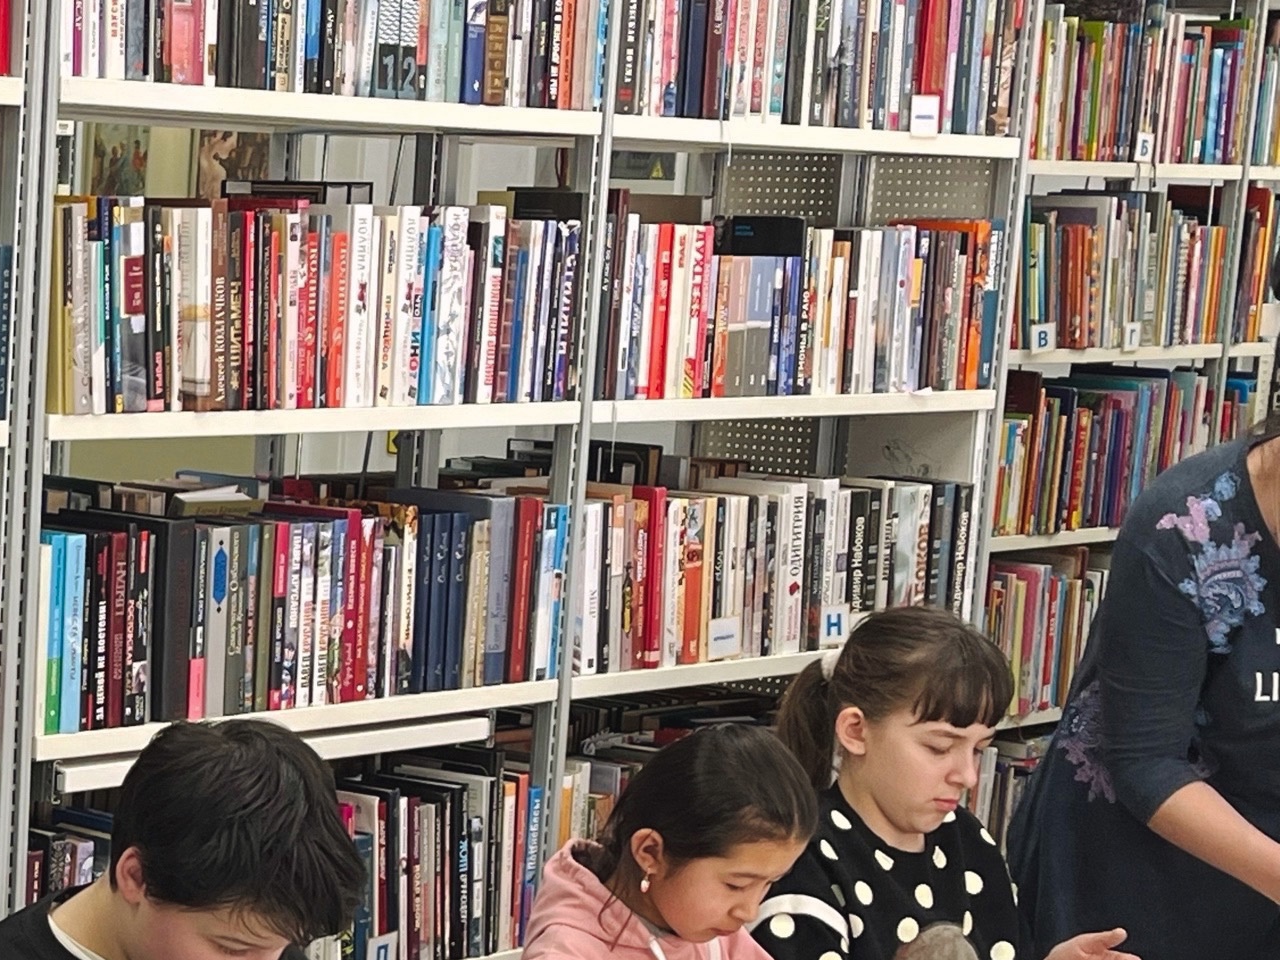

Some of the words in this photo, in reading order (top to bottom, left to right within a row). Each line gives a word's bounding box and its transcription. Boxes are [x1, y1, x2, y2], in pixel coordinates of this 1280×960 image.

[214, 276, 226, 352] КОЗЛАЧКОВ
[230, 281, 242, 319] МЕЧ
[215, 355, 226, 402] Алексей
[790, 496, 804, 576] ОДИГИТРИЯ
[853, 516, 865, 567] Набоков
[956, 511, 969, 560] Набоков
